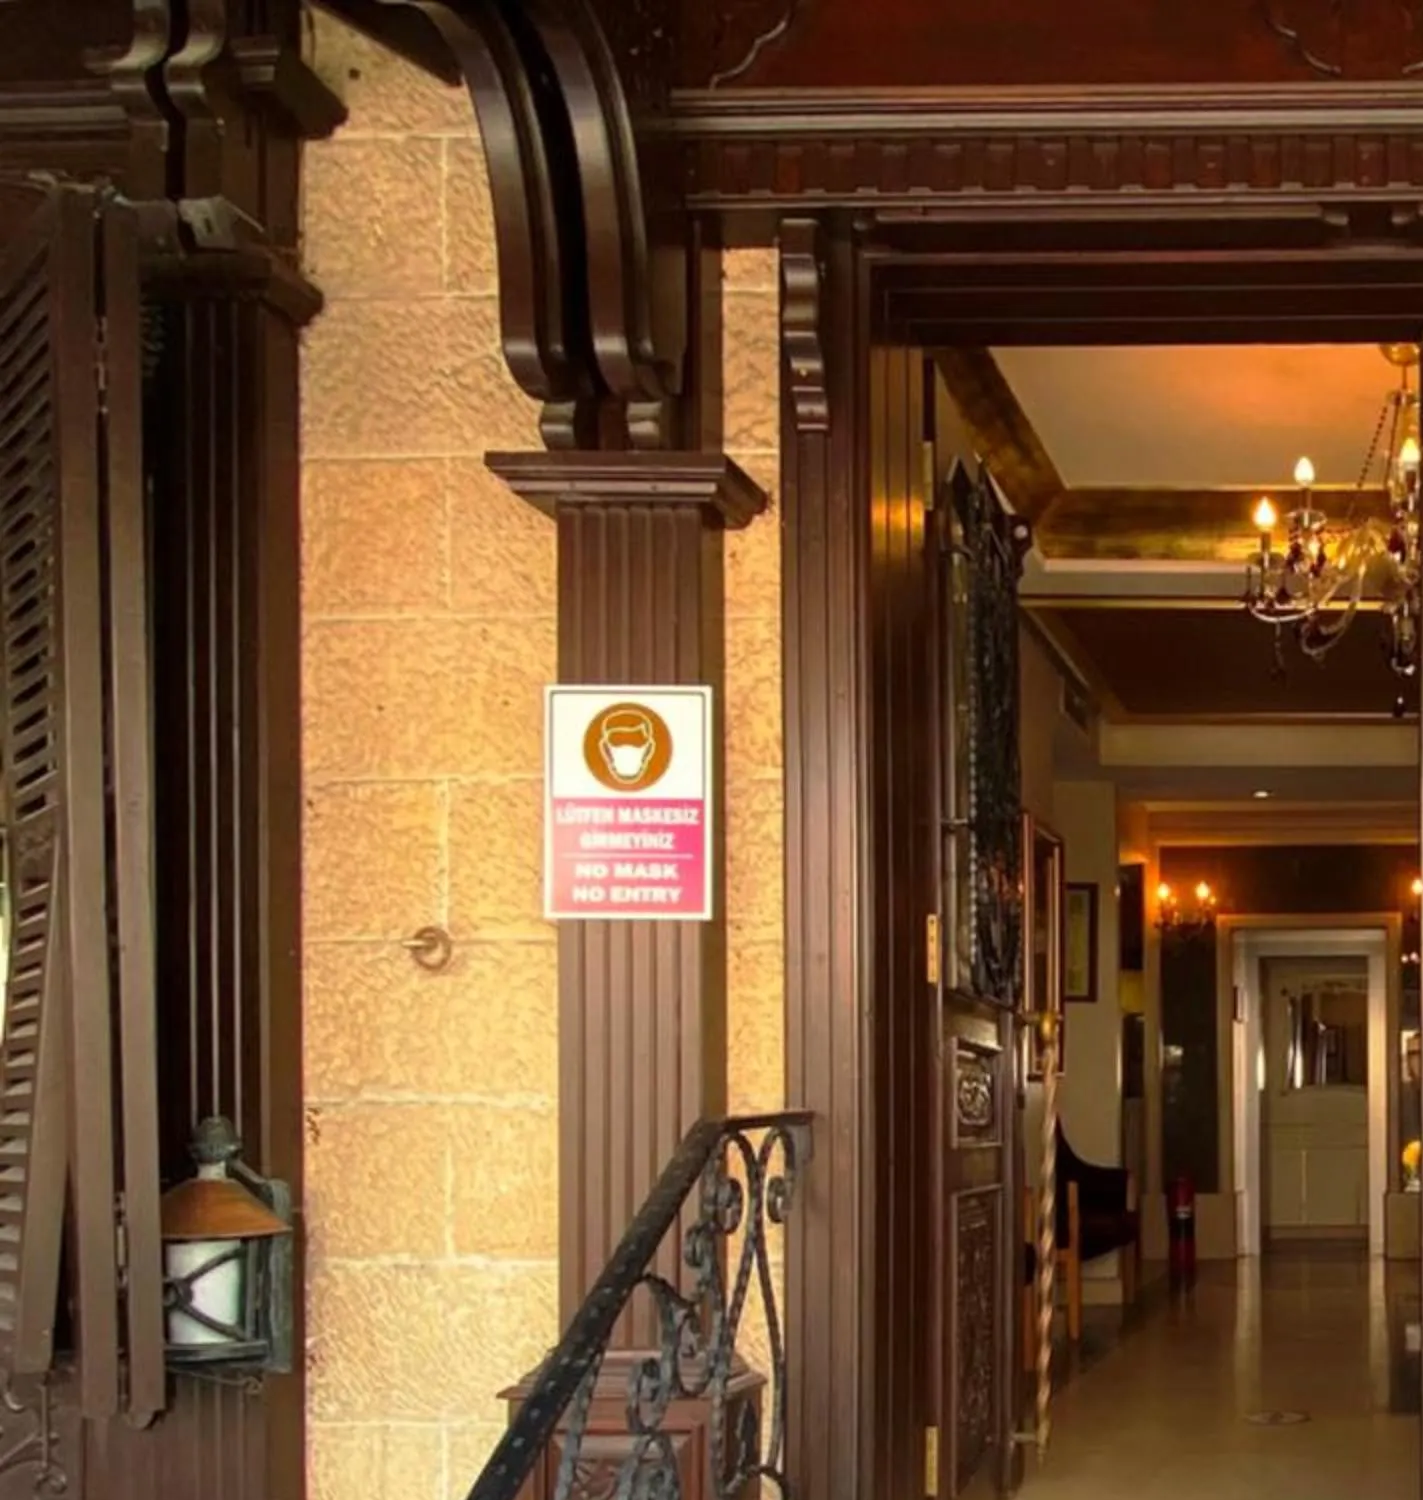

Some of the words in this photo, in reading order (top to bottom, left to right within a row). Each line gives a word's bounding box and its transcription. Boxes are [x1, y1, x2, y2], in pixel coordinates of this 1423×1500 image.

[574, 863, 609, 879] NO
[613, 863, 680, 879] MASK
[571, 886, 606, 903] NO
[610, 886, 682, 903] ENTRY
